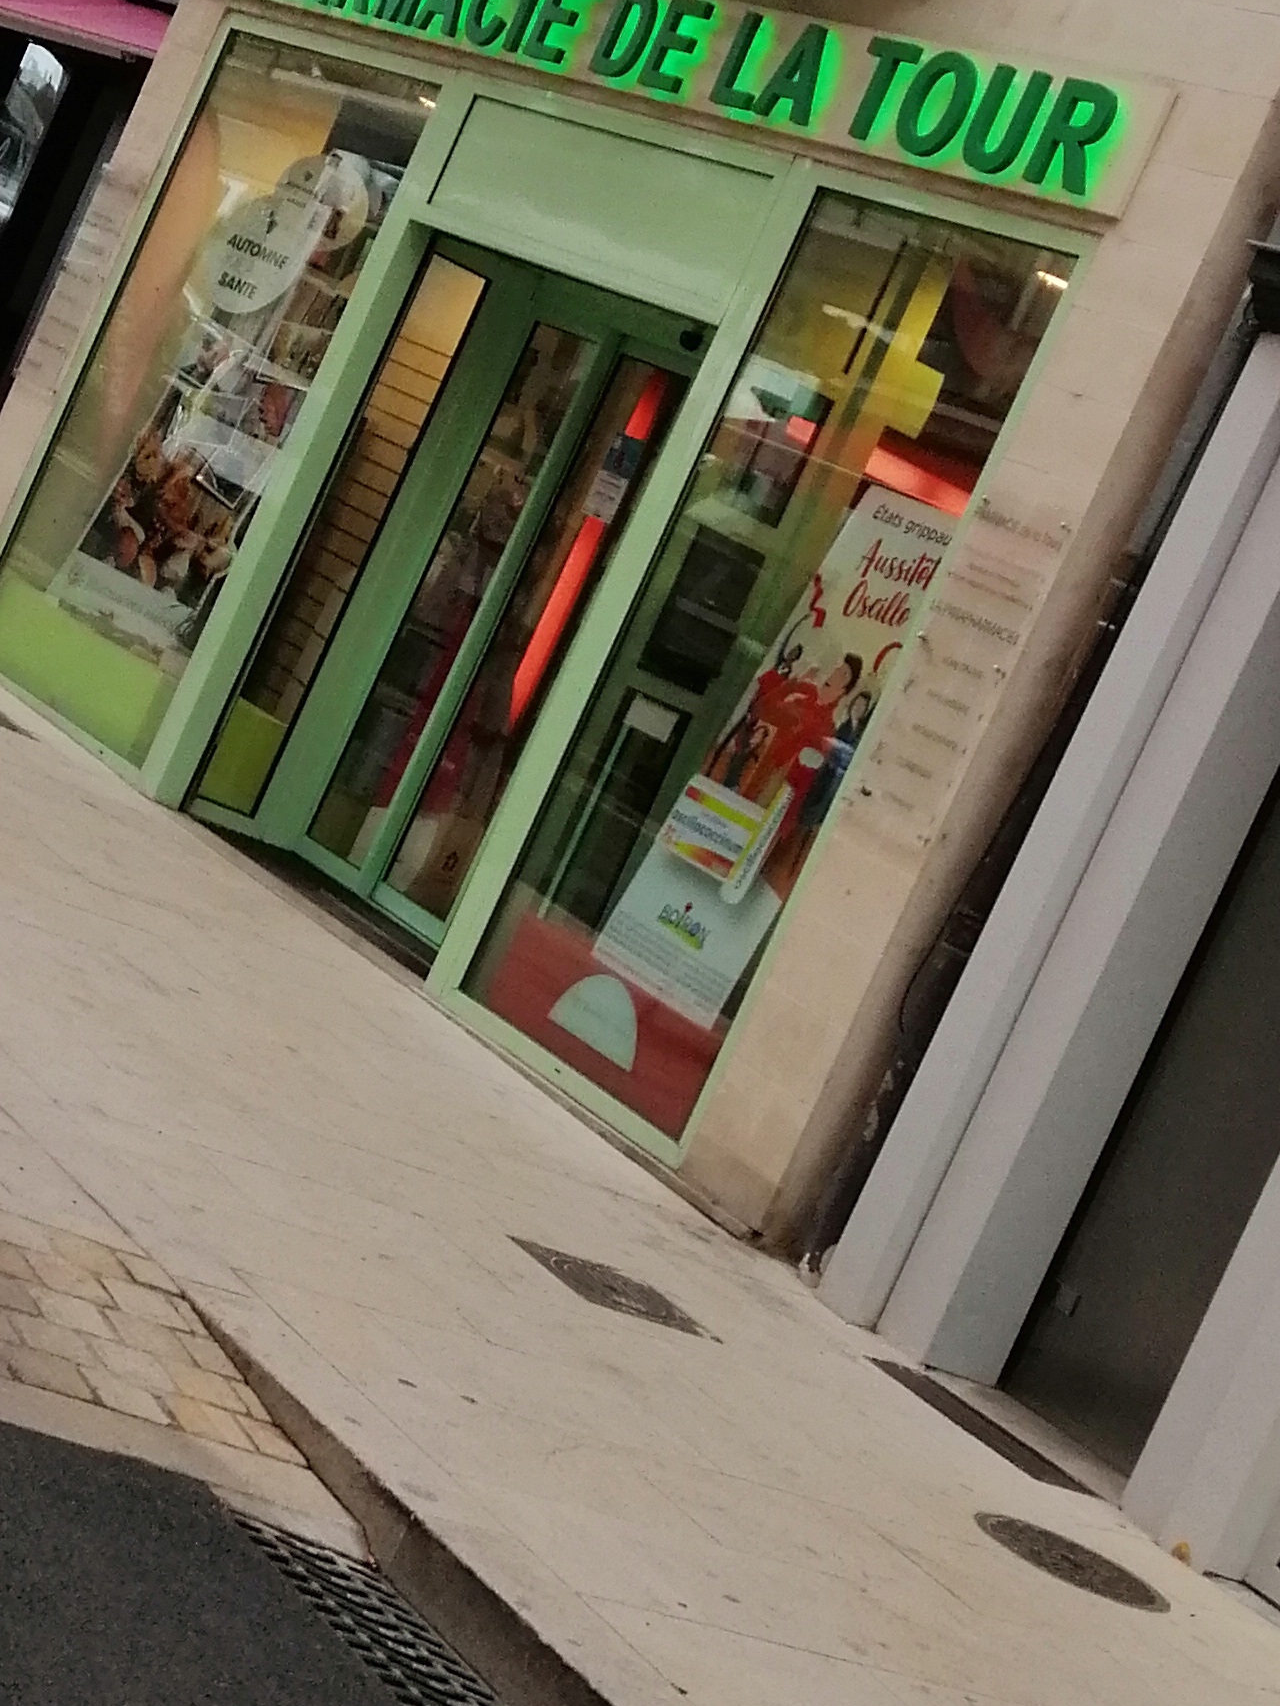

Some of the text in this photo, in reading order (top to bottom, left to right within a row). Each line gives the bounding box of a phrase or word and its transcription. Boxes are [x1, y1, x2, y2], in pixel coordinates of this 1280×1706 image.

[709, 11, 831, 127] LA
[847, 36, 1121, 199] TOUR
[227, 232, 290, 271] AUTOMNE
[841, 572, 912, 627] Oscillo
[658, 903, 710, 947] BOIRON
